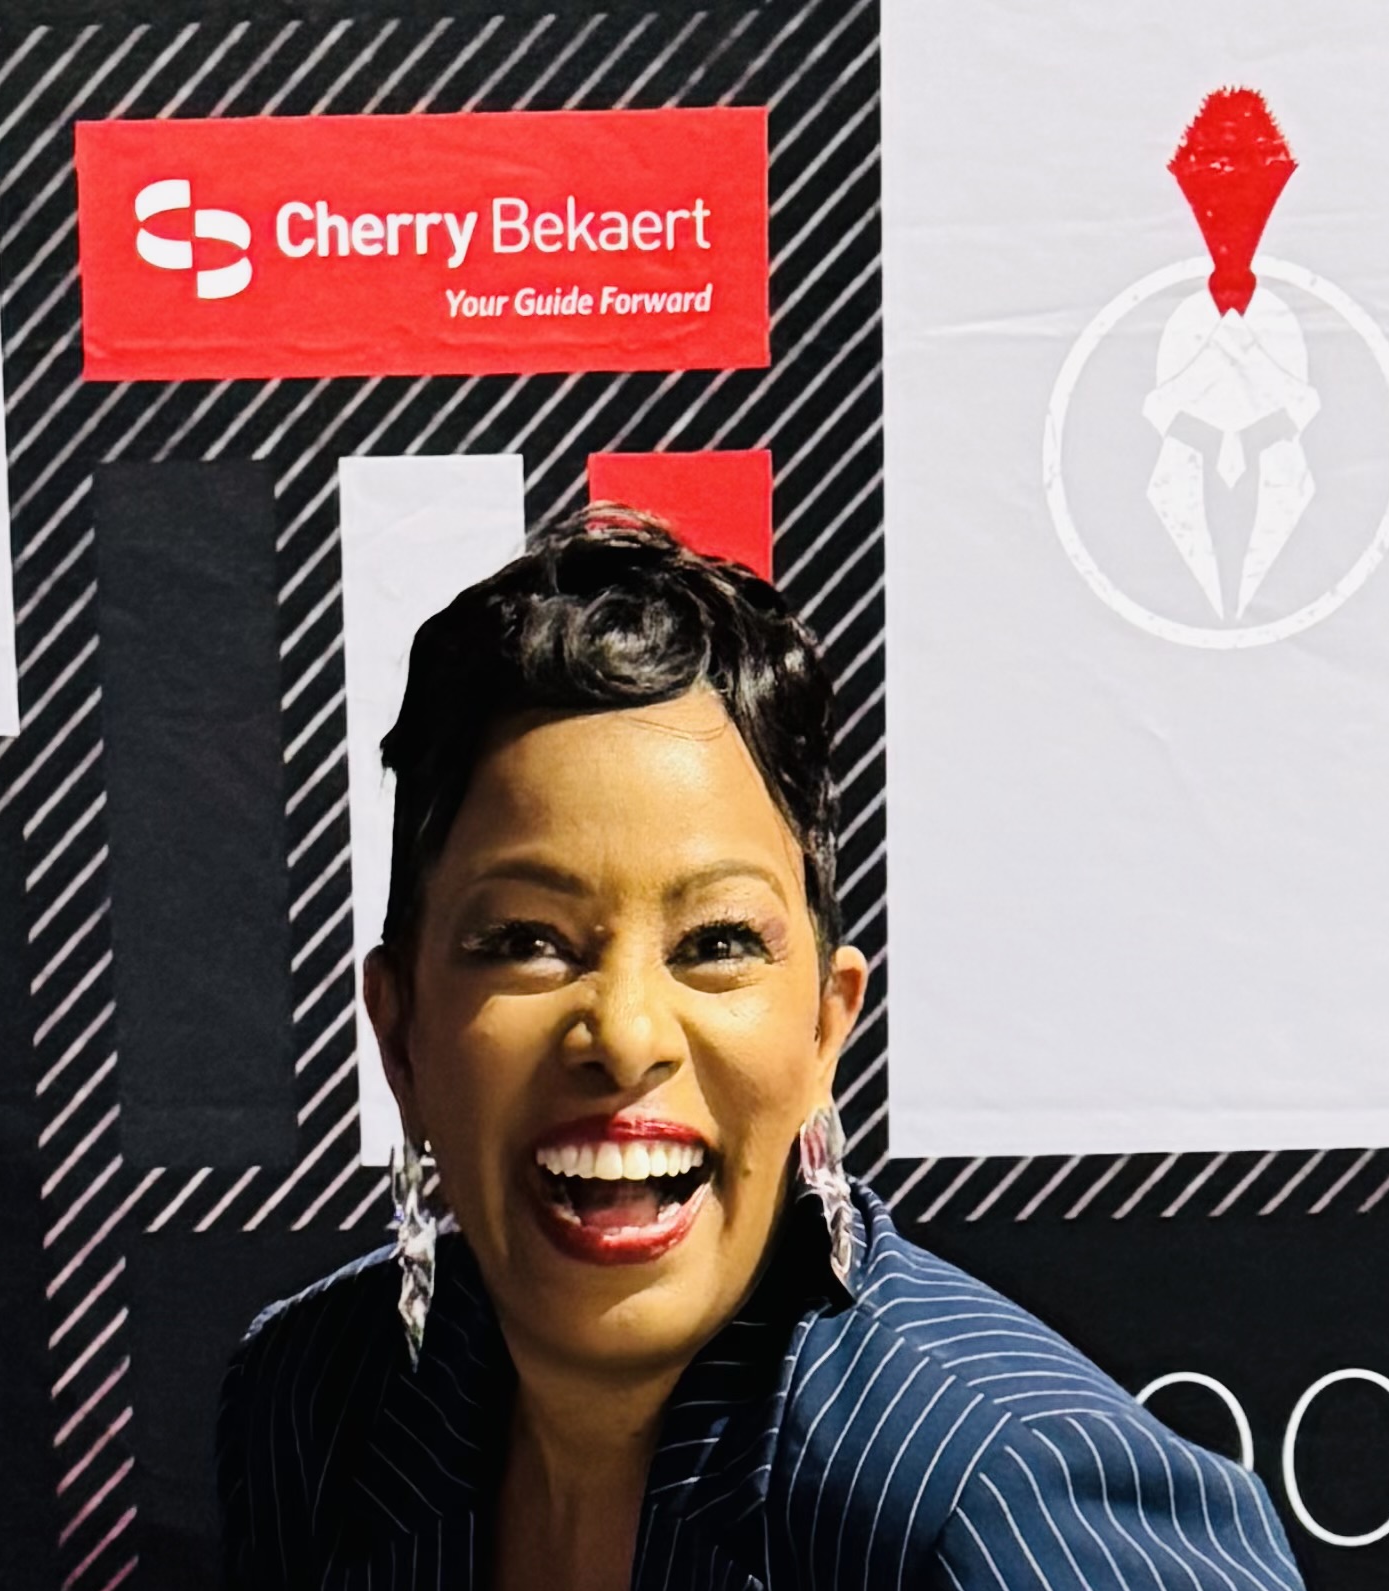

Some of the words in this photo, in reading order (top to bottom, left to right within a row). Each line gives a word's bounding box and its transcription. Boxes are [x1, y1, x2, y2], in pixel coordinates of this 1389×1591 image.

[275, 200, 478, 269] Cherry
[492, 195, 712, 254] Bekaert
[445, 287, 510, 318] Your
[513, 284, 594, 317] Guide
[599, 283, 713, 316] Forward
